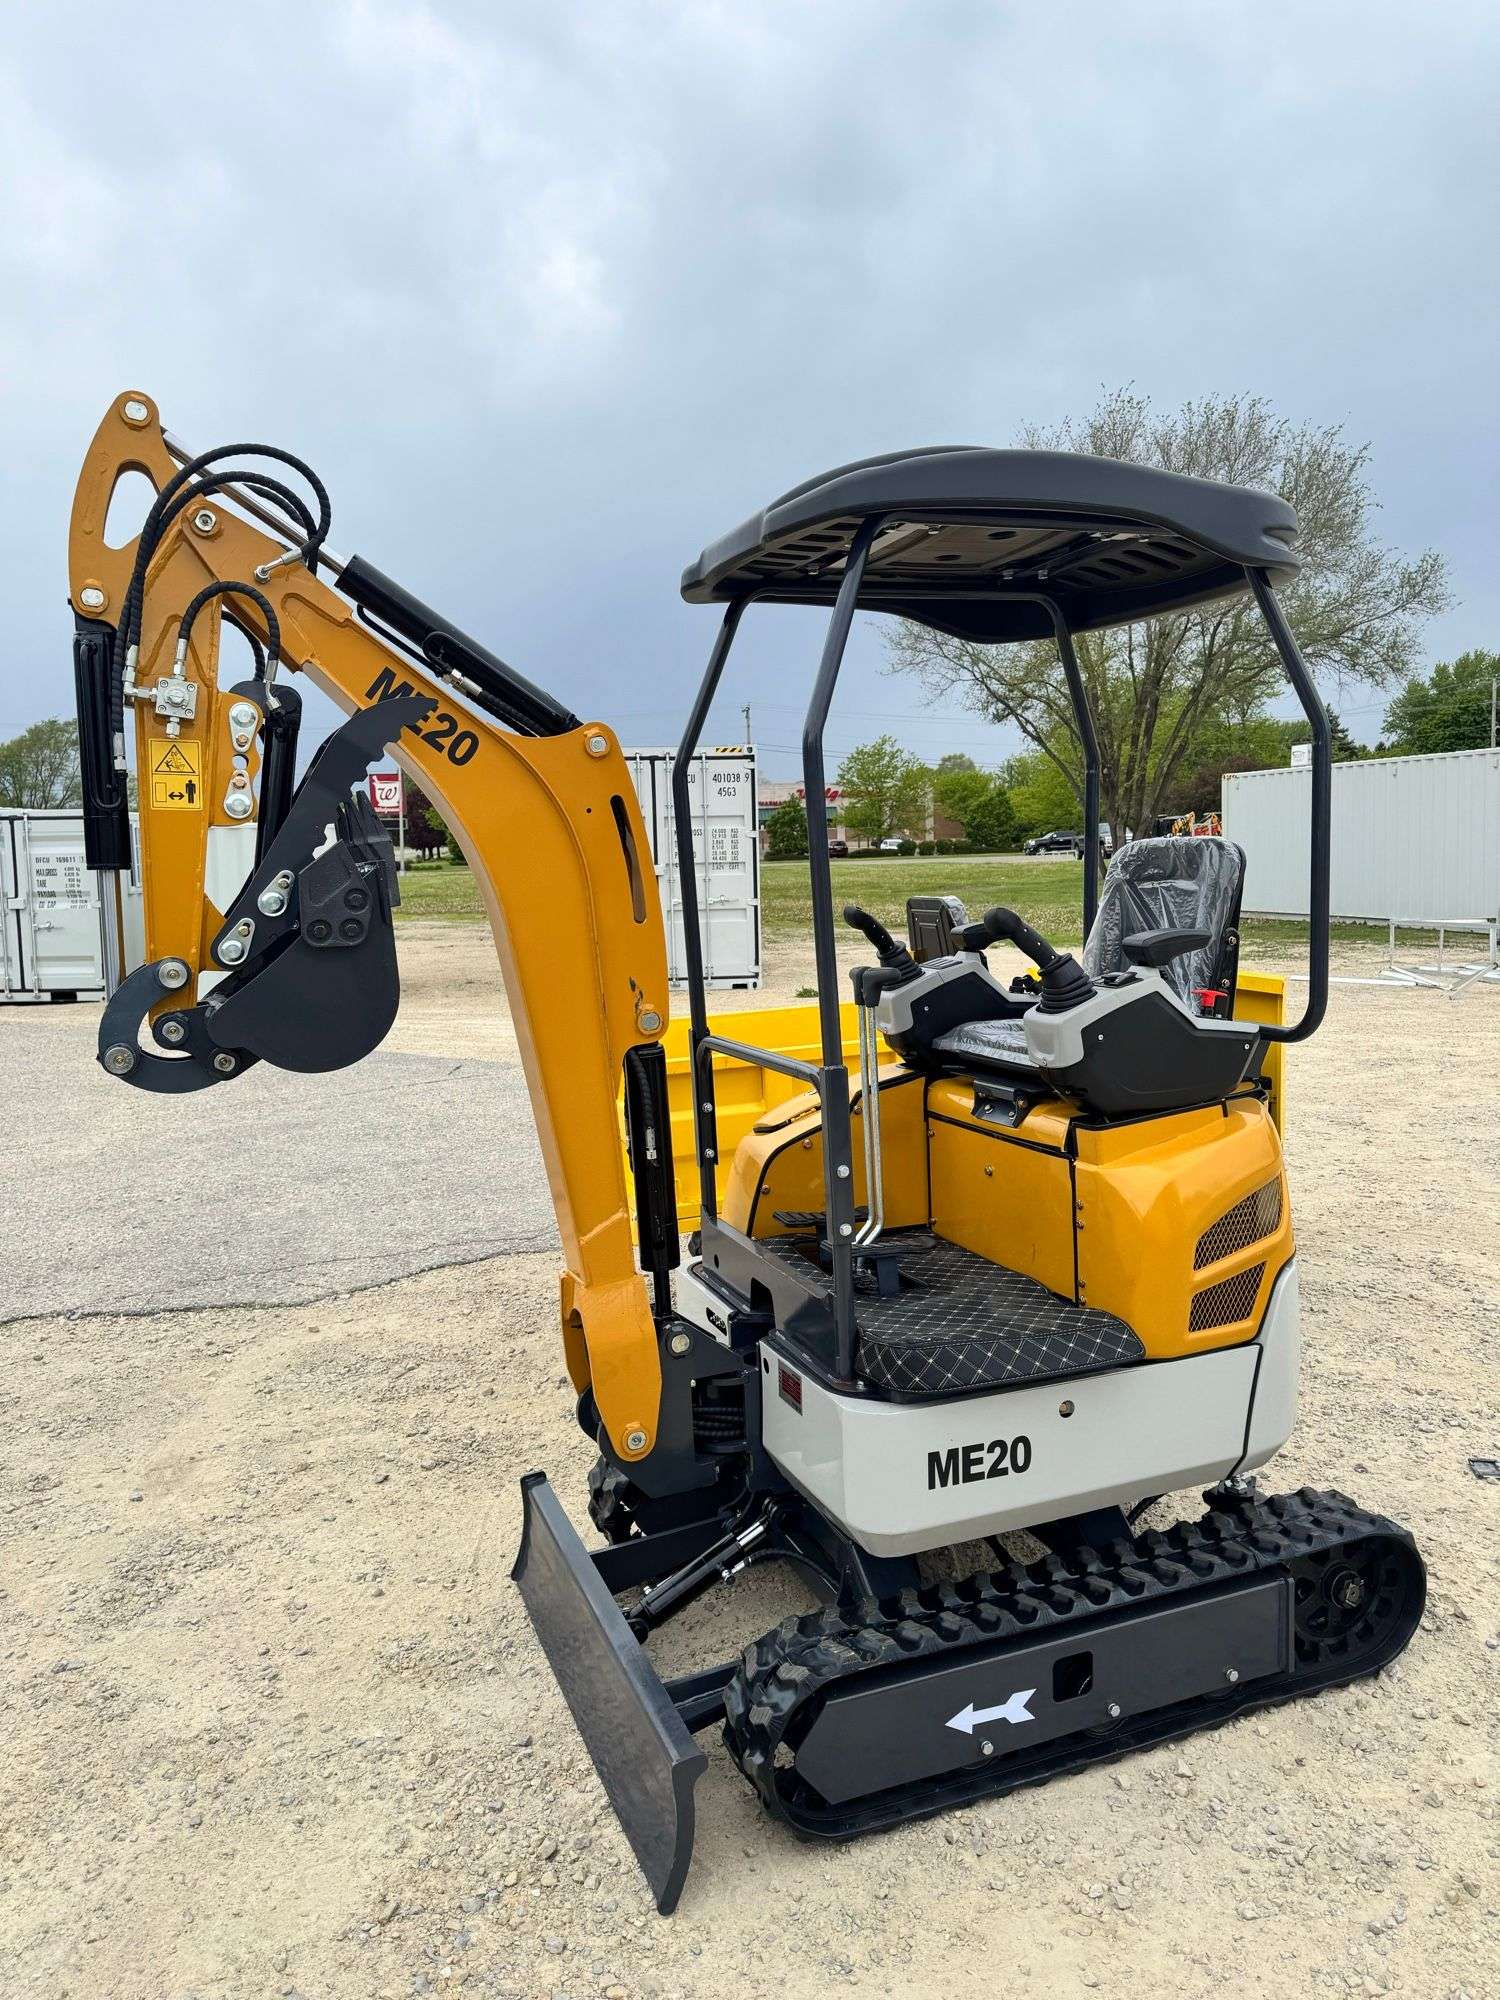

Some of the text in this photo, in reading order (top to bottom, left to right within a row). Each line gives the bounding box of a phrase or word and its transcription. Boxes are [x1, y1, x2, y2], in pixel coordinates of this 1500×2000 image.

[712, 773, 741, 783] 401038
[744, 773, 750, 783] 9
[718, 787, 737, 797] 45G3
[927, 1435, 1032, 1490] ME20
